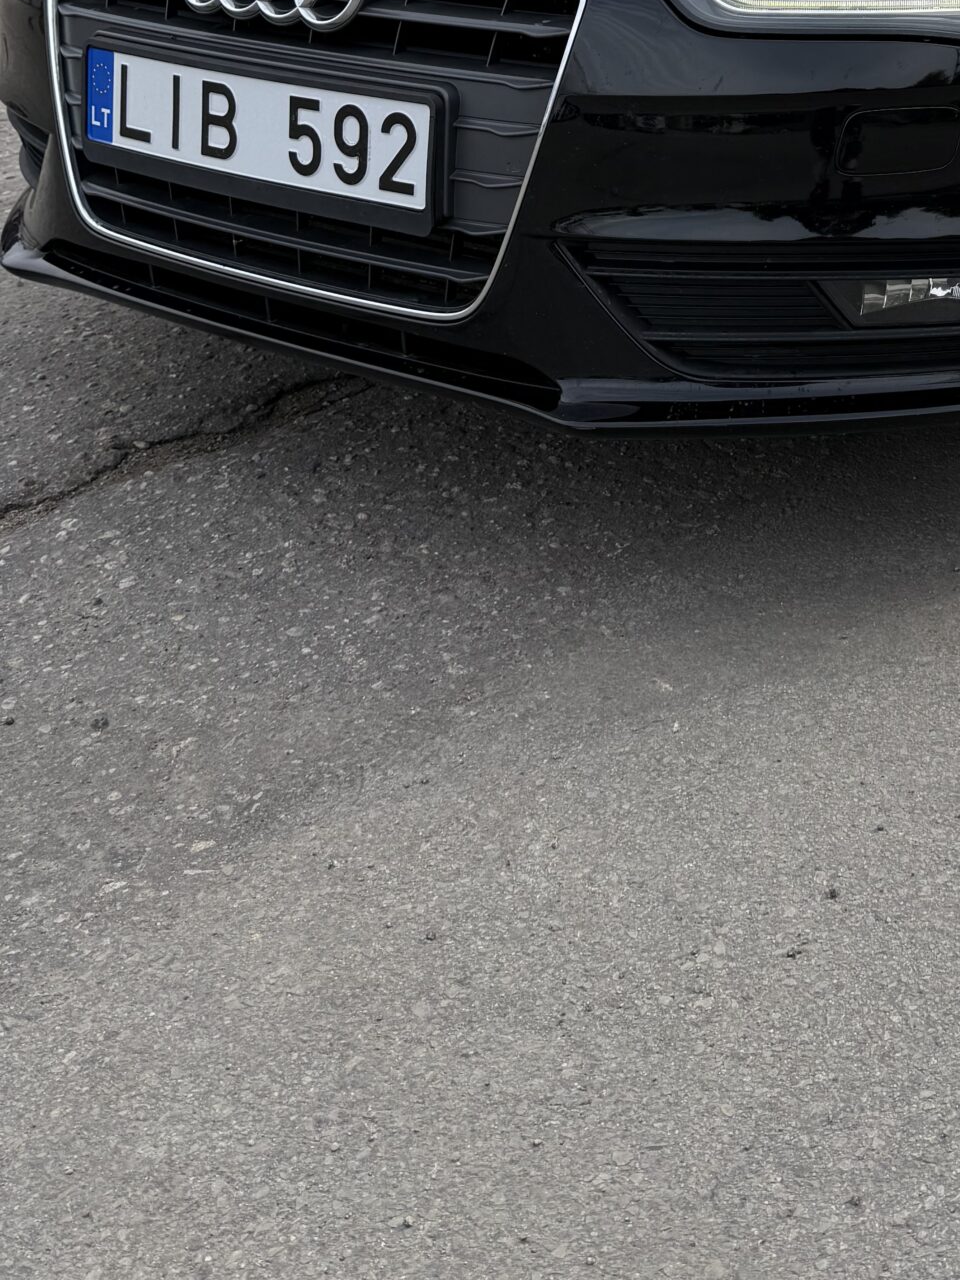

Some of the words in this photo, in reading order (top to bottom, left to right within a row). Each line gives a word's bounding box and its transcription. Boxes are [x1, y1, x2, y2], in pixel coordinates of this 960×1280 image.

[91, 104, 111, 128] LT
[119, 63, 238, 160] LIB
[288, 94, 417, 196] 592
